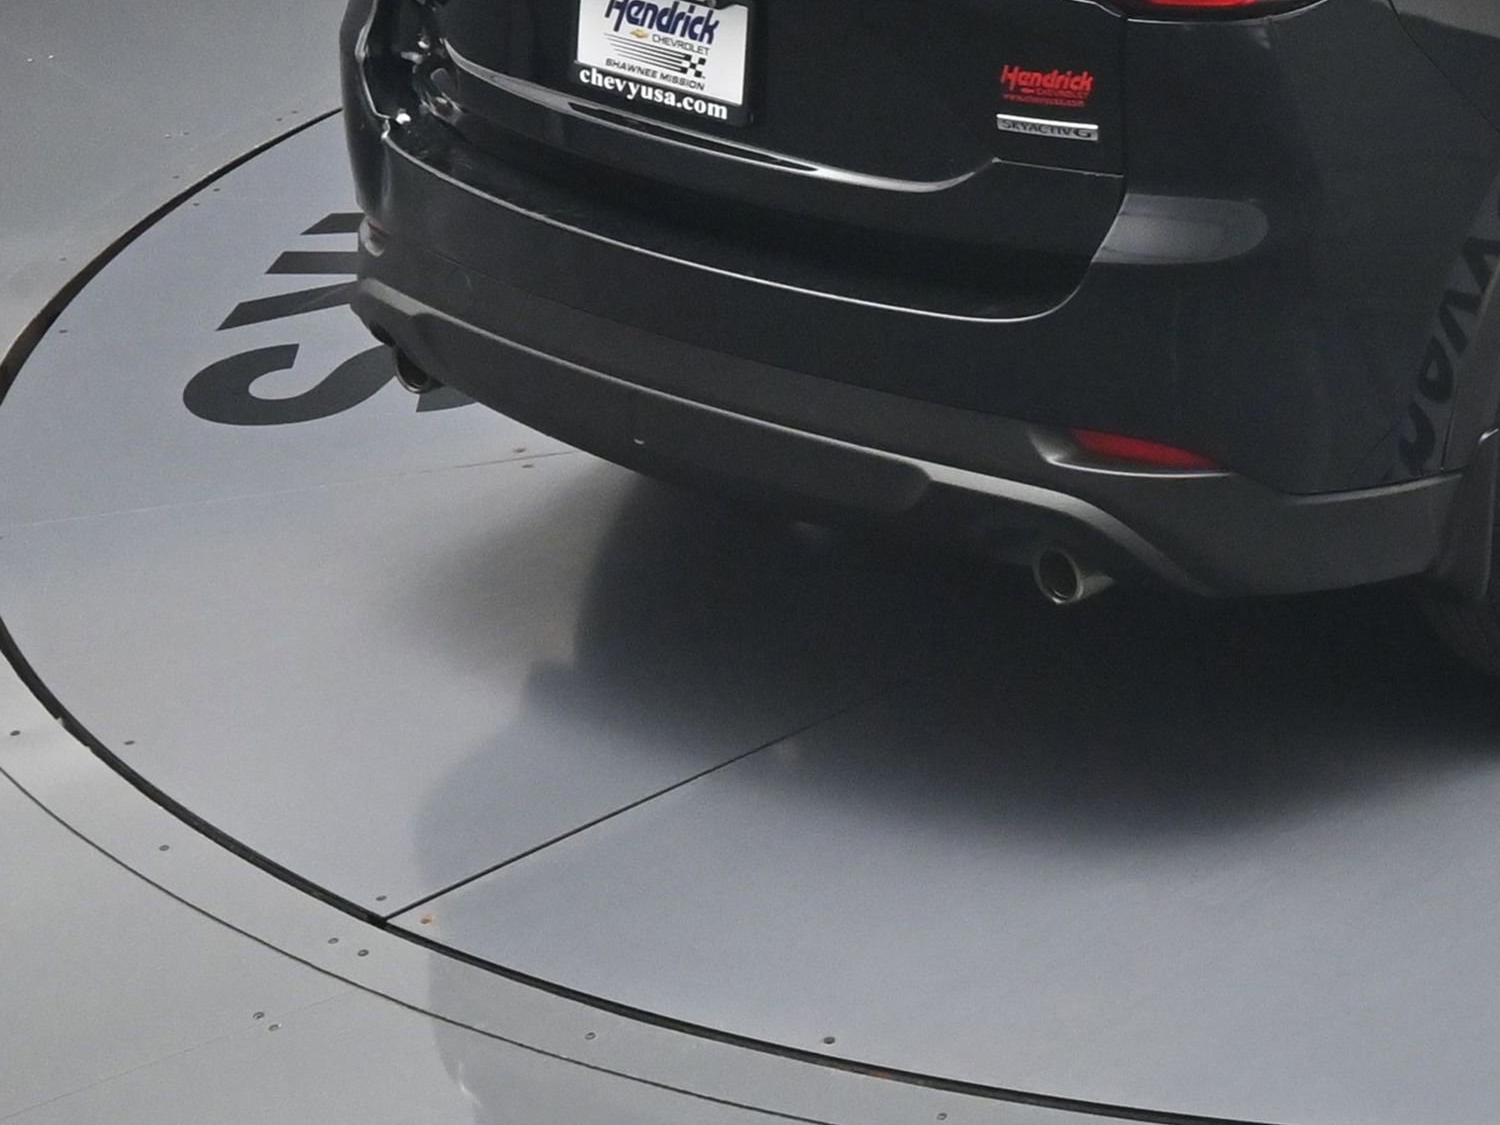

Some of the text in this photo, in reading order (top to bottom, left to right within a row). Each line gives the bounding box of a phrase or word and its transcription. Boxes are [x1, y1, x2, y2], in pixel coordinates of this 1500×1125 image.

[652, 33, 710, 56] CHEVROLET
[605, 58, 705, 92] SHAWNEE MISSION
[1001, 64, 1093, 92] Hendrick
[579, 66, 728, 120] chevyusa.com
